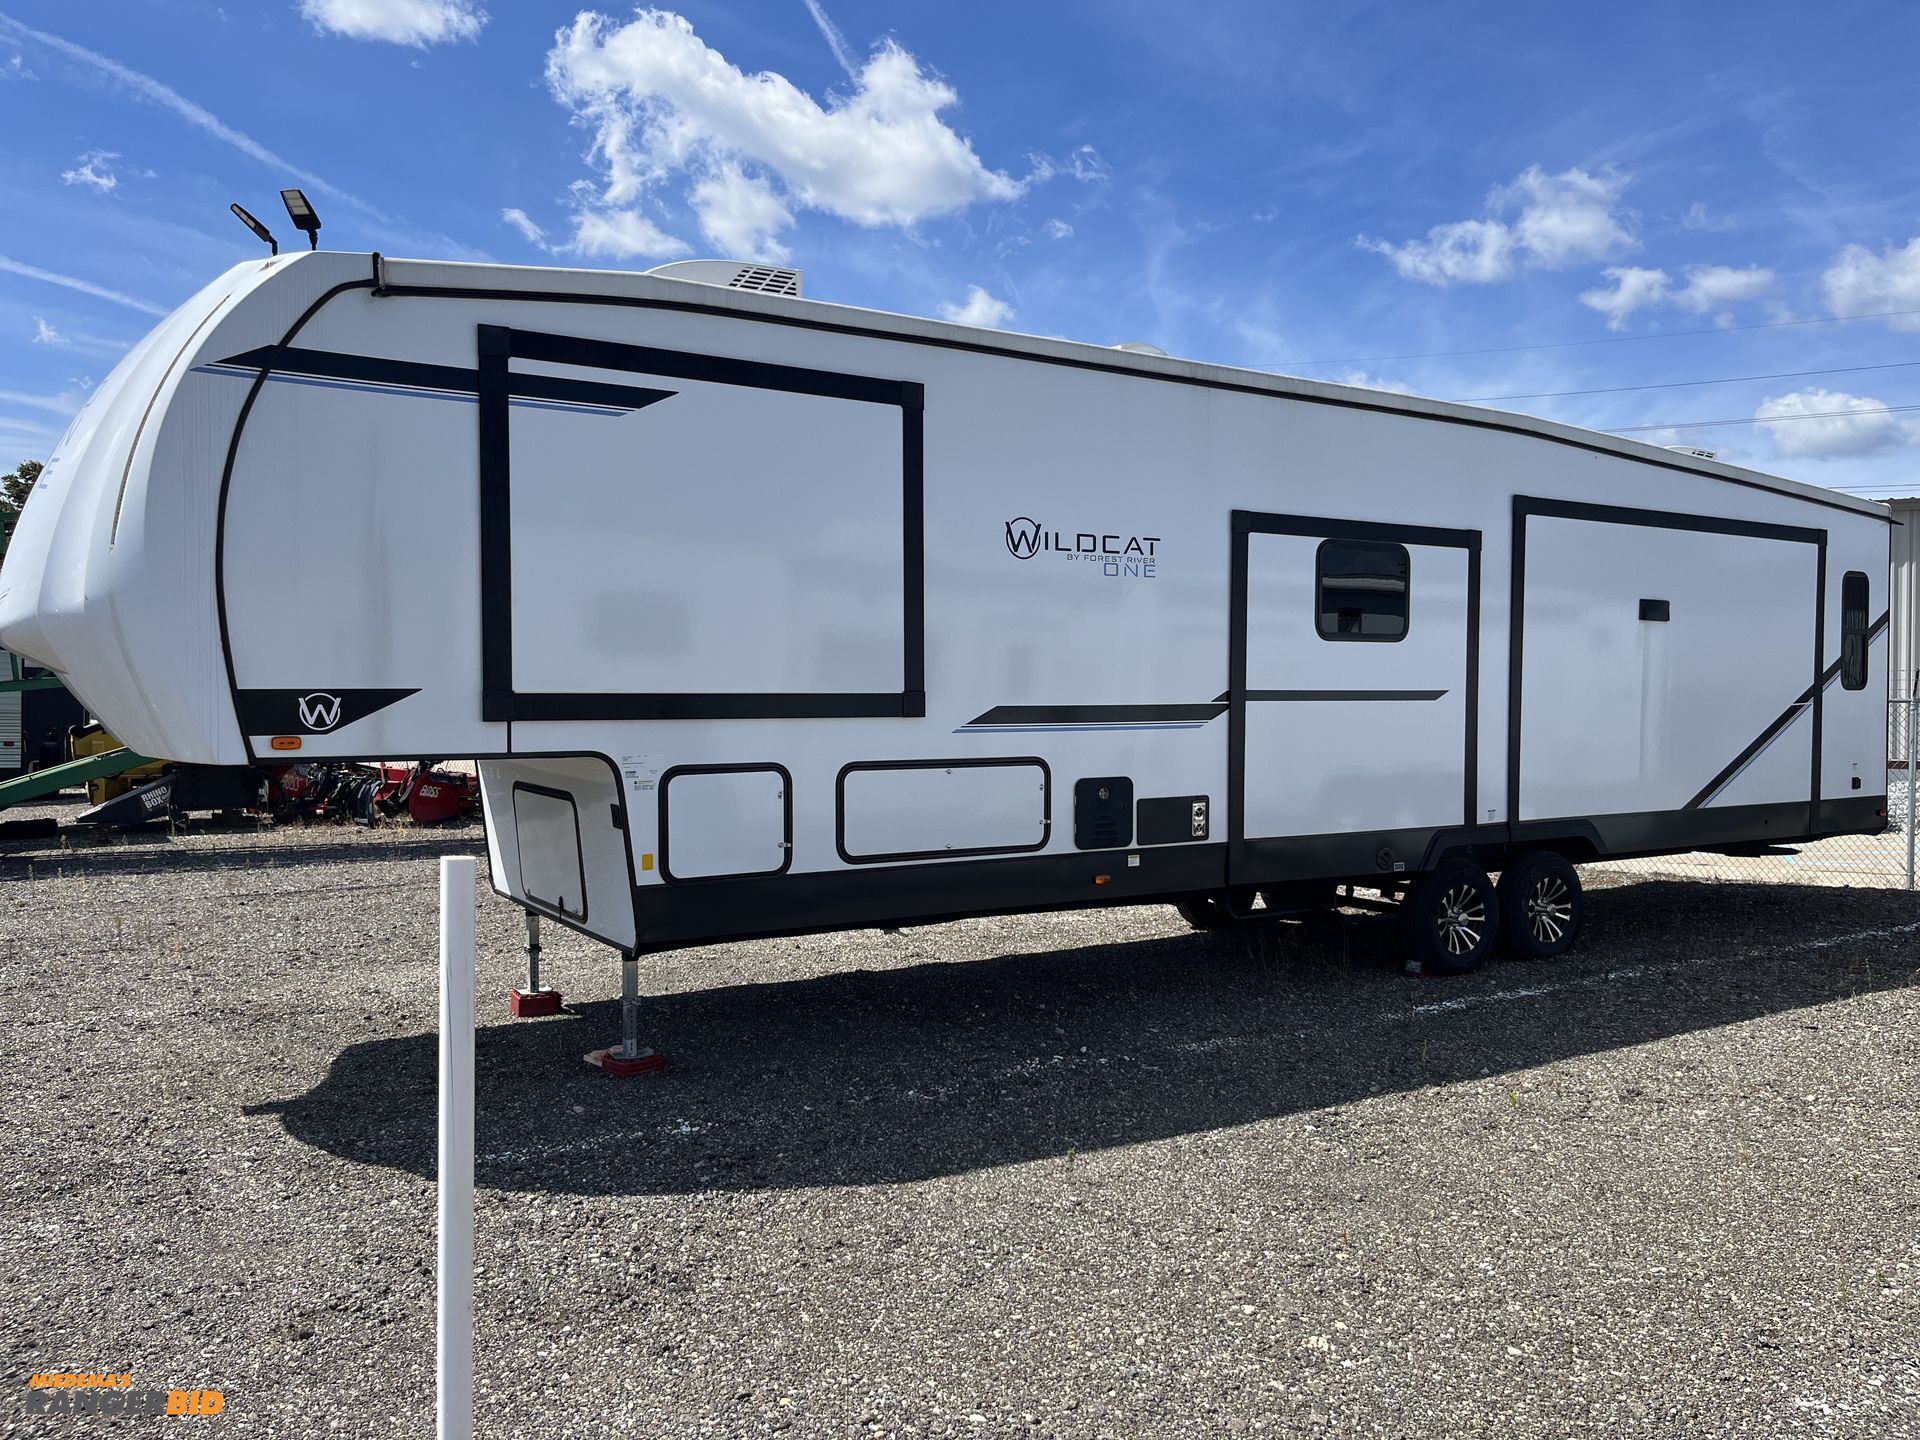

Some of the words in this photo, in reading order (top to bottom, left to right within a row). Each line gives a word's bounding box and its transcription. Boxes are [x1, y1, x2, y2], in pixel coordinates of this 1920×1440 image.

[1004, 517, 1162, 559] WILDCAT
[1066, 553, 1080, 561] BY
[1083, 554, 1124, 563] FOREST
[1126, 556, 1156, 564] RIVER
[1103, 562, 1157, 578] ONE
[298, 692, 341, 731] W
[140, 786, 168, 802] RHINO
[419, 784, 442, 798] BOSS
[144, 796, 164, 809] BOX
